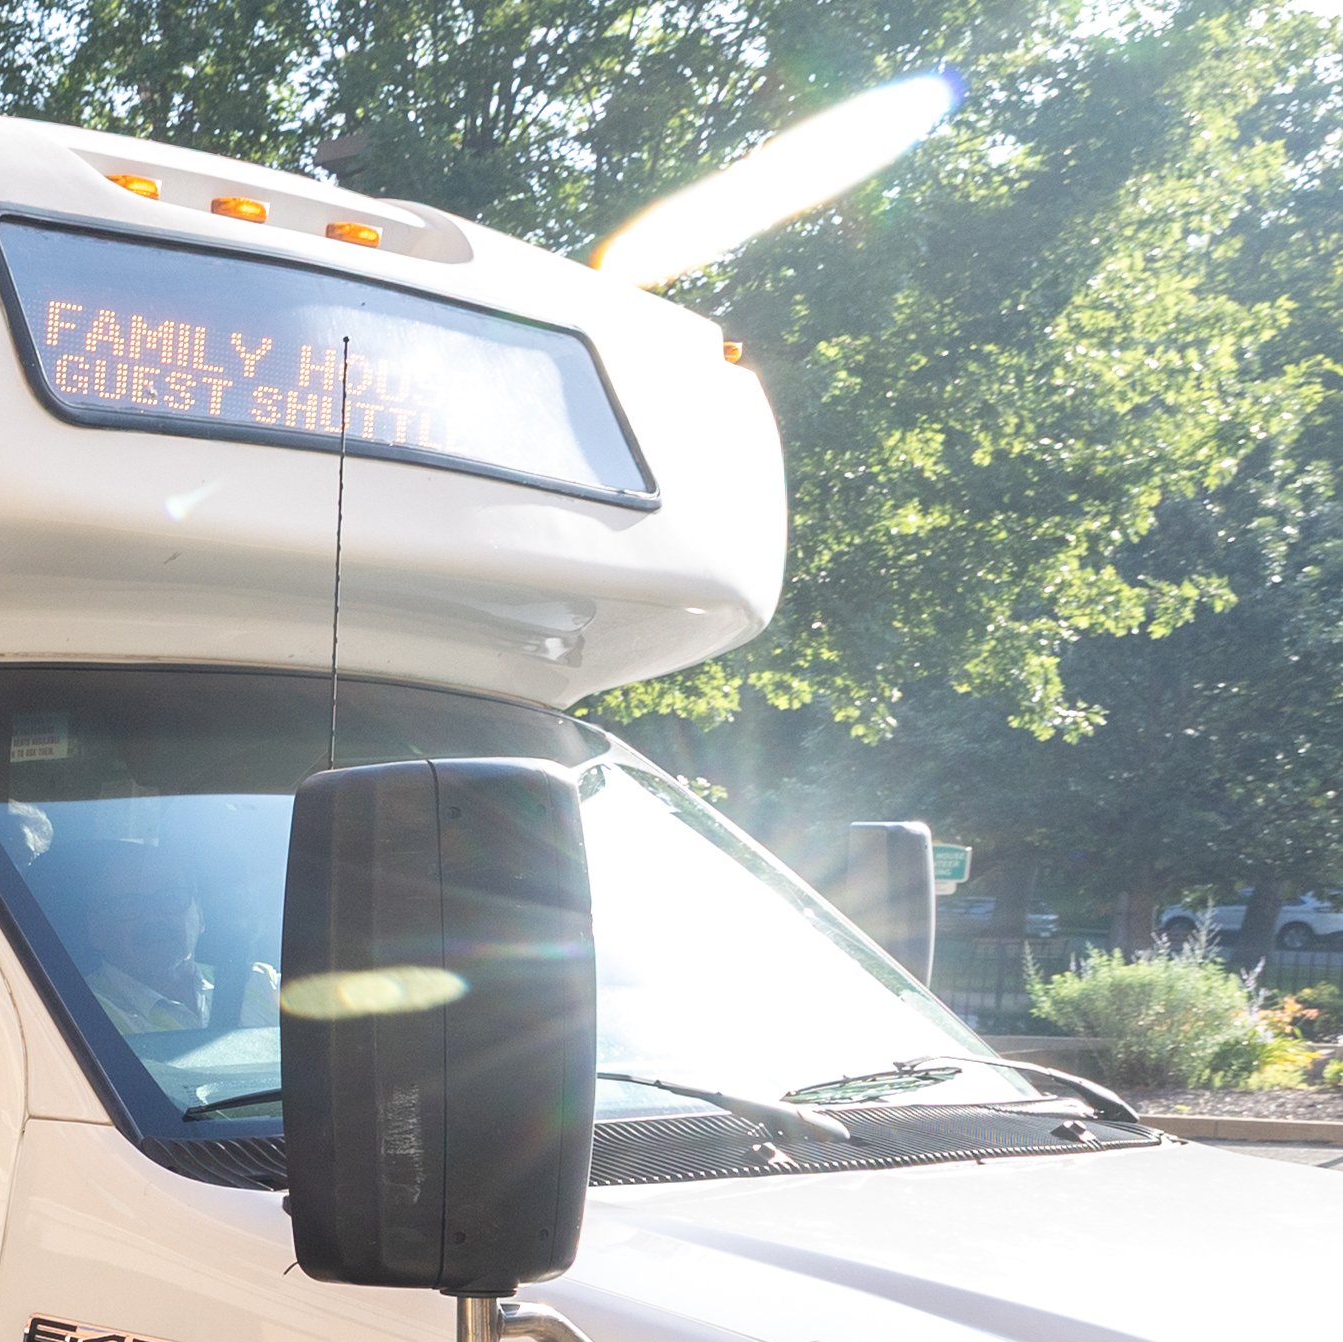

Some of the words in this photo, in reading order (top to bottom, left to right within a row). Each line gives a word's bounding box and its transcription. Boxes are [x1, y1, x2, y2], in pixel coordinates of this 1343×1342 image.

[46, 300, 273, 378] FAMILY
[298, 344, 443, 408] HOU
[54, 353, 234, 416] GUEST
[250, 385, 470, 455] SHUTTL
